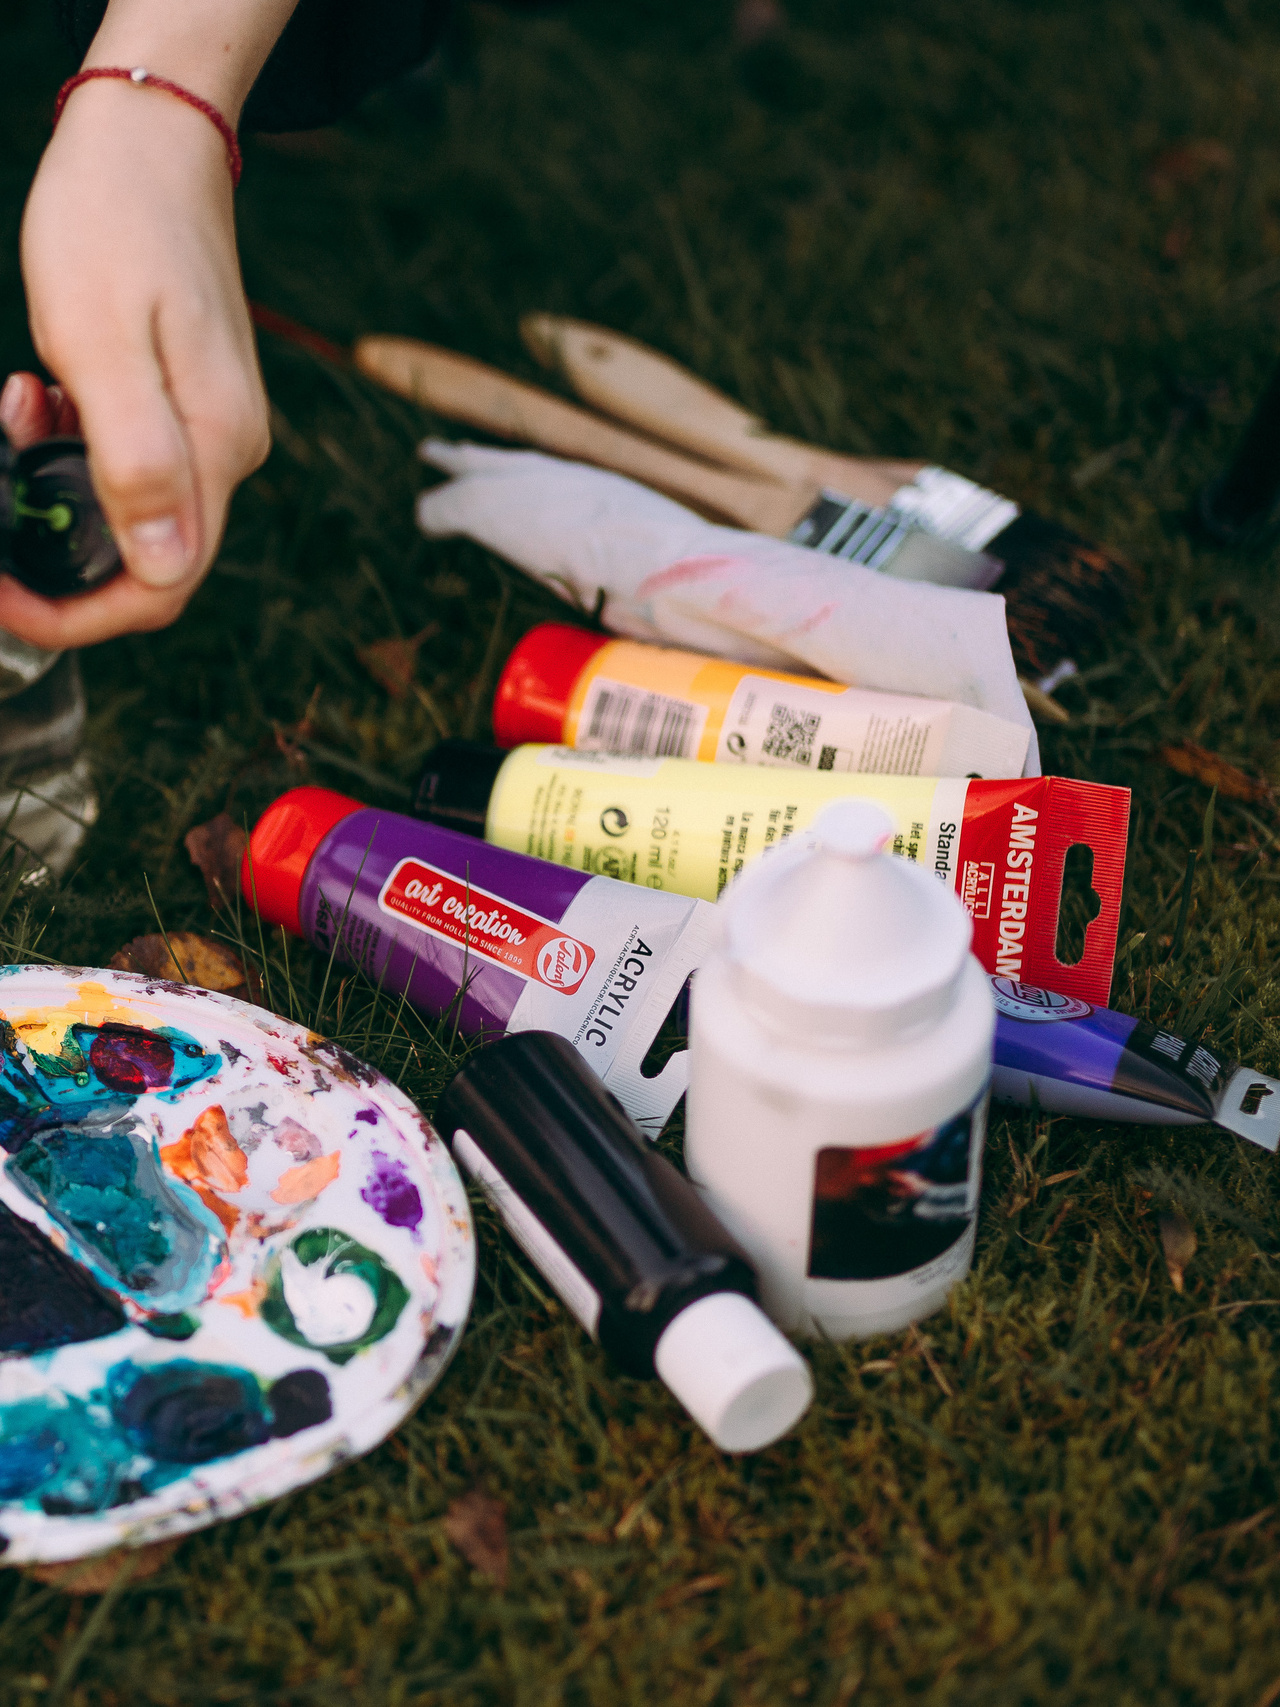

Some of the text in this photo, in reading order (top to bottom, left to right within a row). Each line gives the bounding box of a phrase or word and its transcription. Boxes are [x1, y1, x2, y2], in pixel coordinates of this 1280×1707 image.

[650, 806, 671, 840] 120
[736, 826, 749, 854] marca
[910, 821, 924, 840] Het
[647, 843, 663, 869] ml
[963, 860, 980, 917] ACRYLICS
[974, 871, 991, 910] ALL
[995, 802, 1039, 983] AMSTERDAM
[389, 896, 523, 966] QUALITY FROM HOLLAND SINCE 1899
[404, 878, 527, 947] art creation
[585, 937, 653, 1047] ACRYLIC
[1149, 1030, 1187, 1061] PAINT
[1184, 1045, 1222, 1089] ACRYLIC
